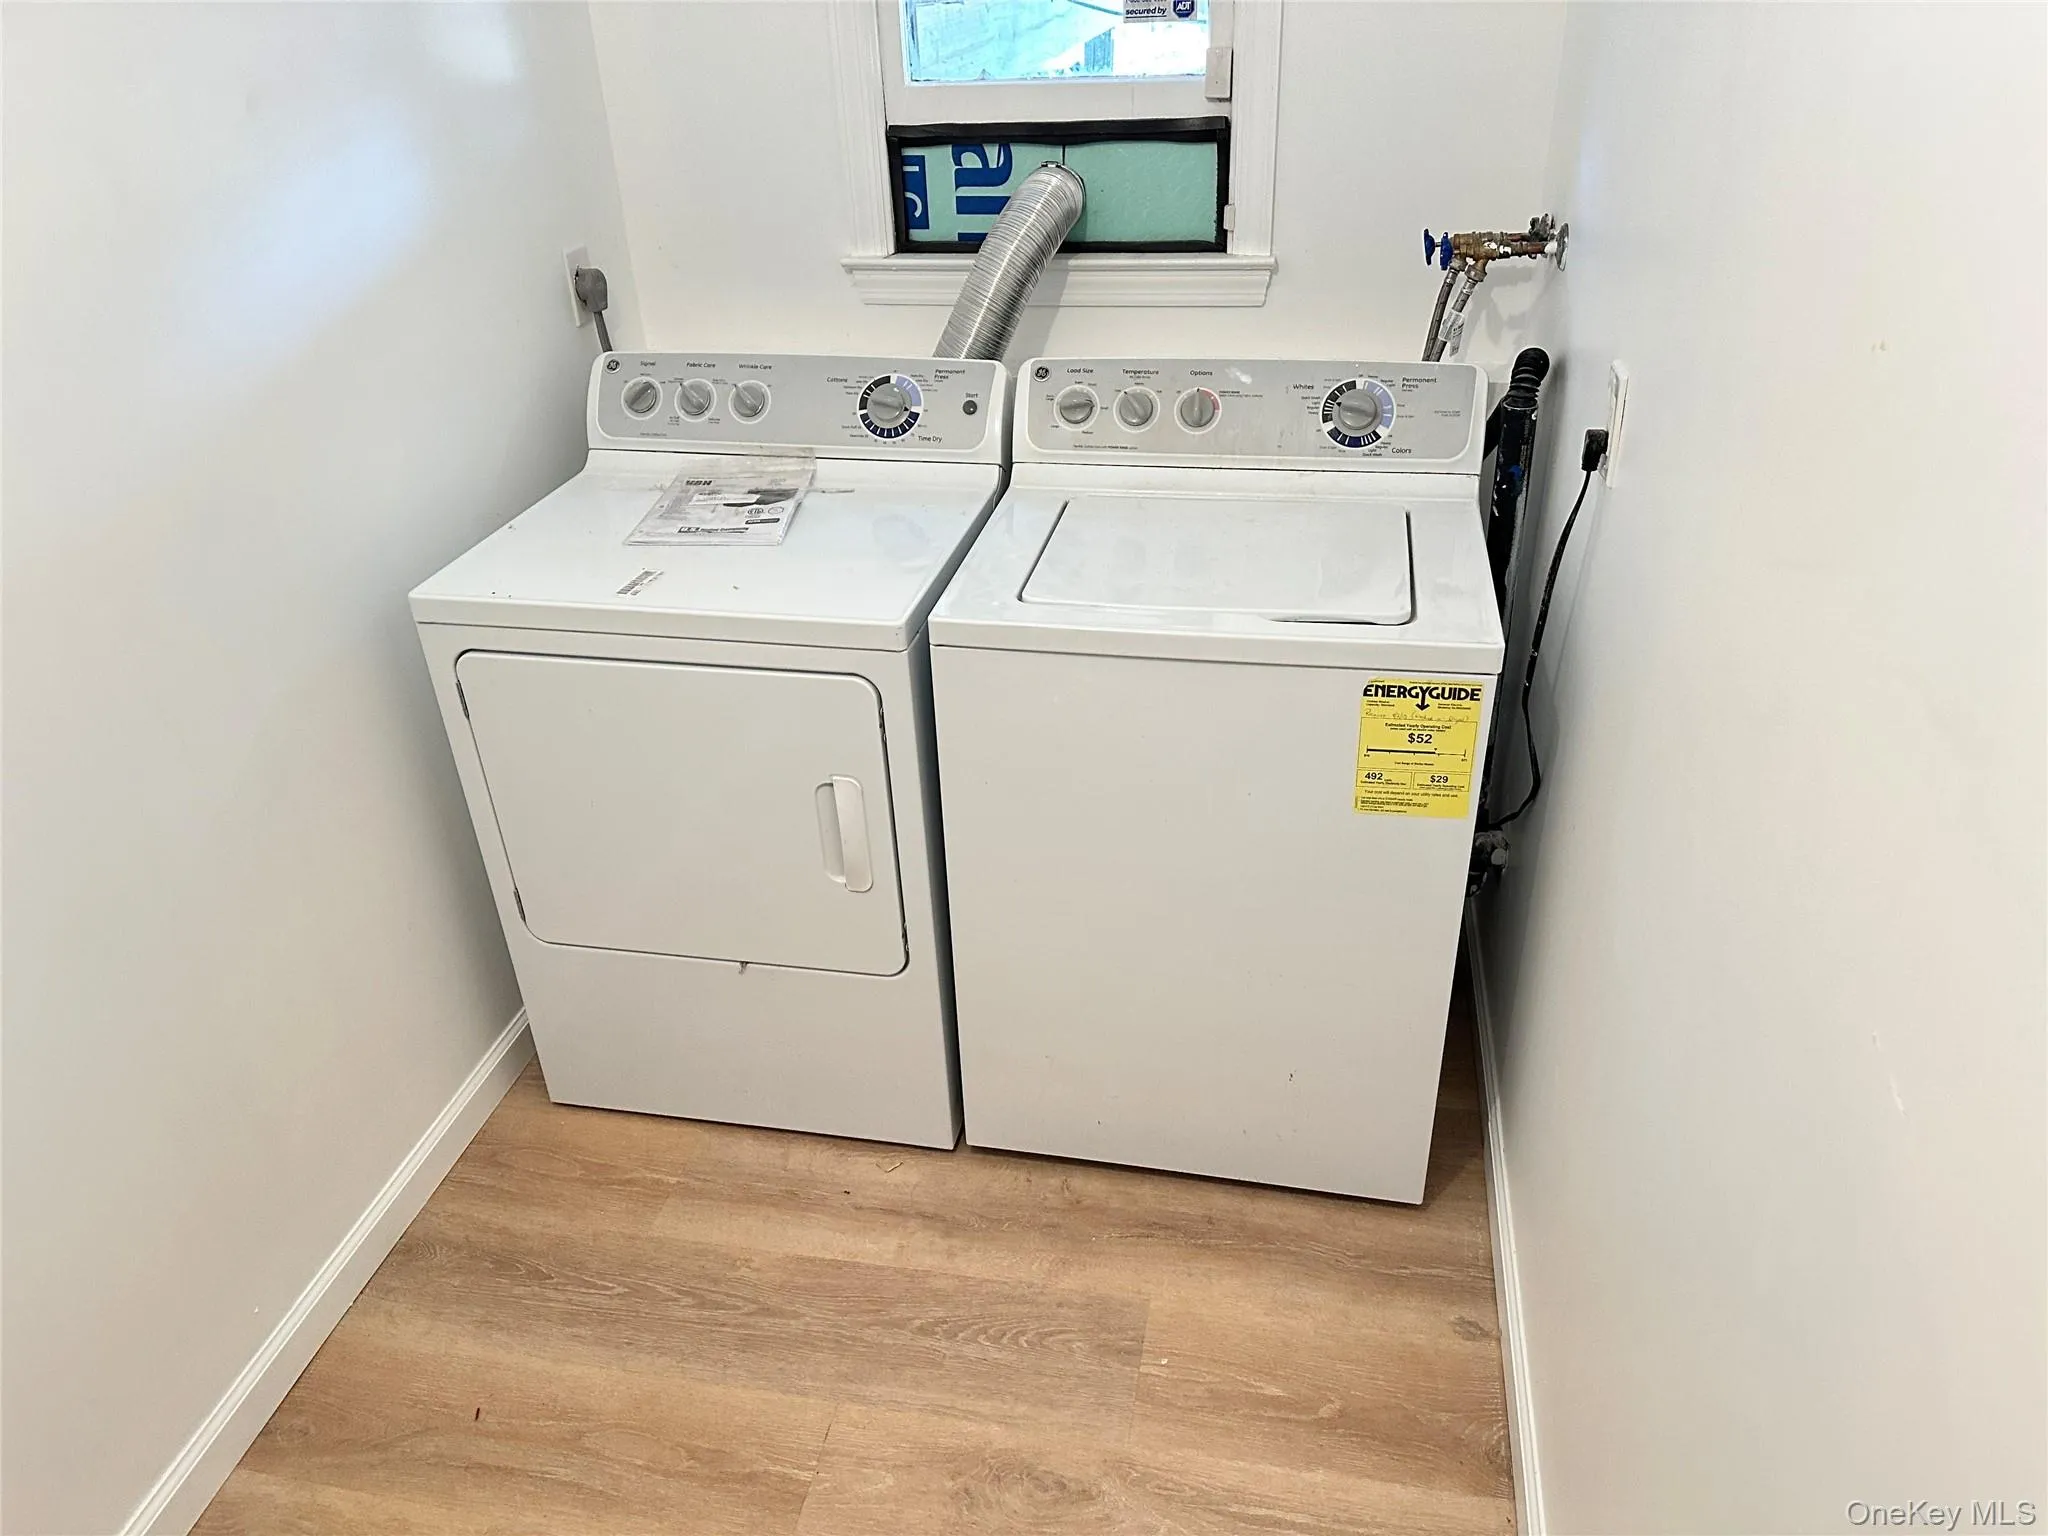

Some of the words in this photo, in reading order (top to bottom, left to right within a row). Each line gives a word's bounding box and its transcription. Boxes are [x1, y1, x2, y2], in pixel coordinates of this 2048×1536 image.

[1125, 6, 1157, 15] secured
[1157, 6, 1167, 15] by
[1176, 2, 1191, 11] ADT
[1122, 368, 1160, 376] Temperature
[1293, 383, 1314, 391] Whites
[932, 436, 942, 444] Dry
[1363, 684, 1481, 702] ENERGYGUIDE
[1407, 732, 1433, 744] $52
[1364, 772, 1384, 781] 492
[1430, 775, 1449, 784] $29
